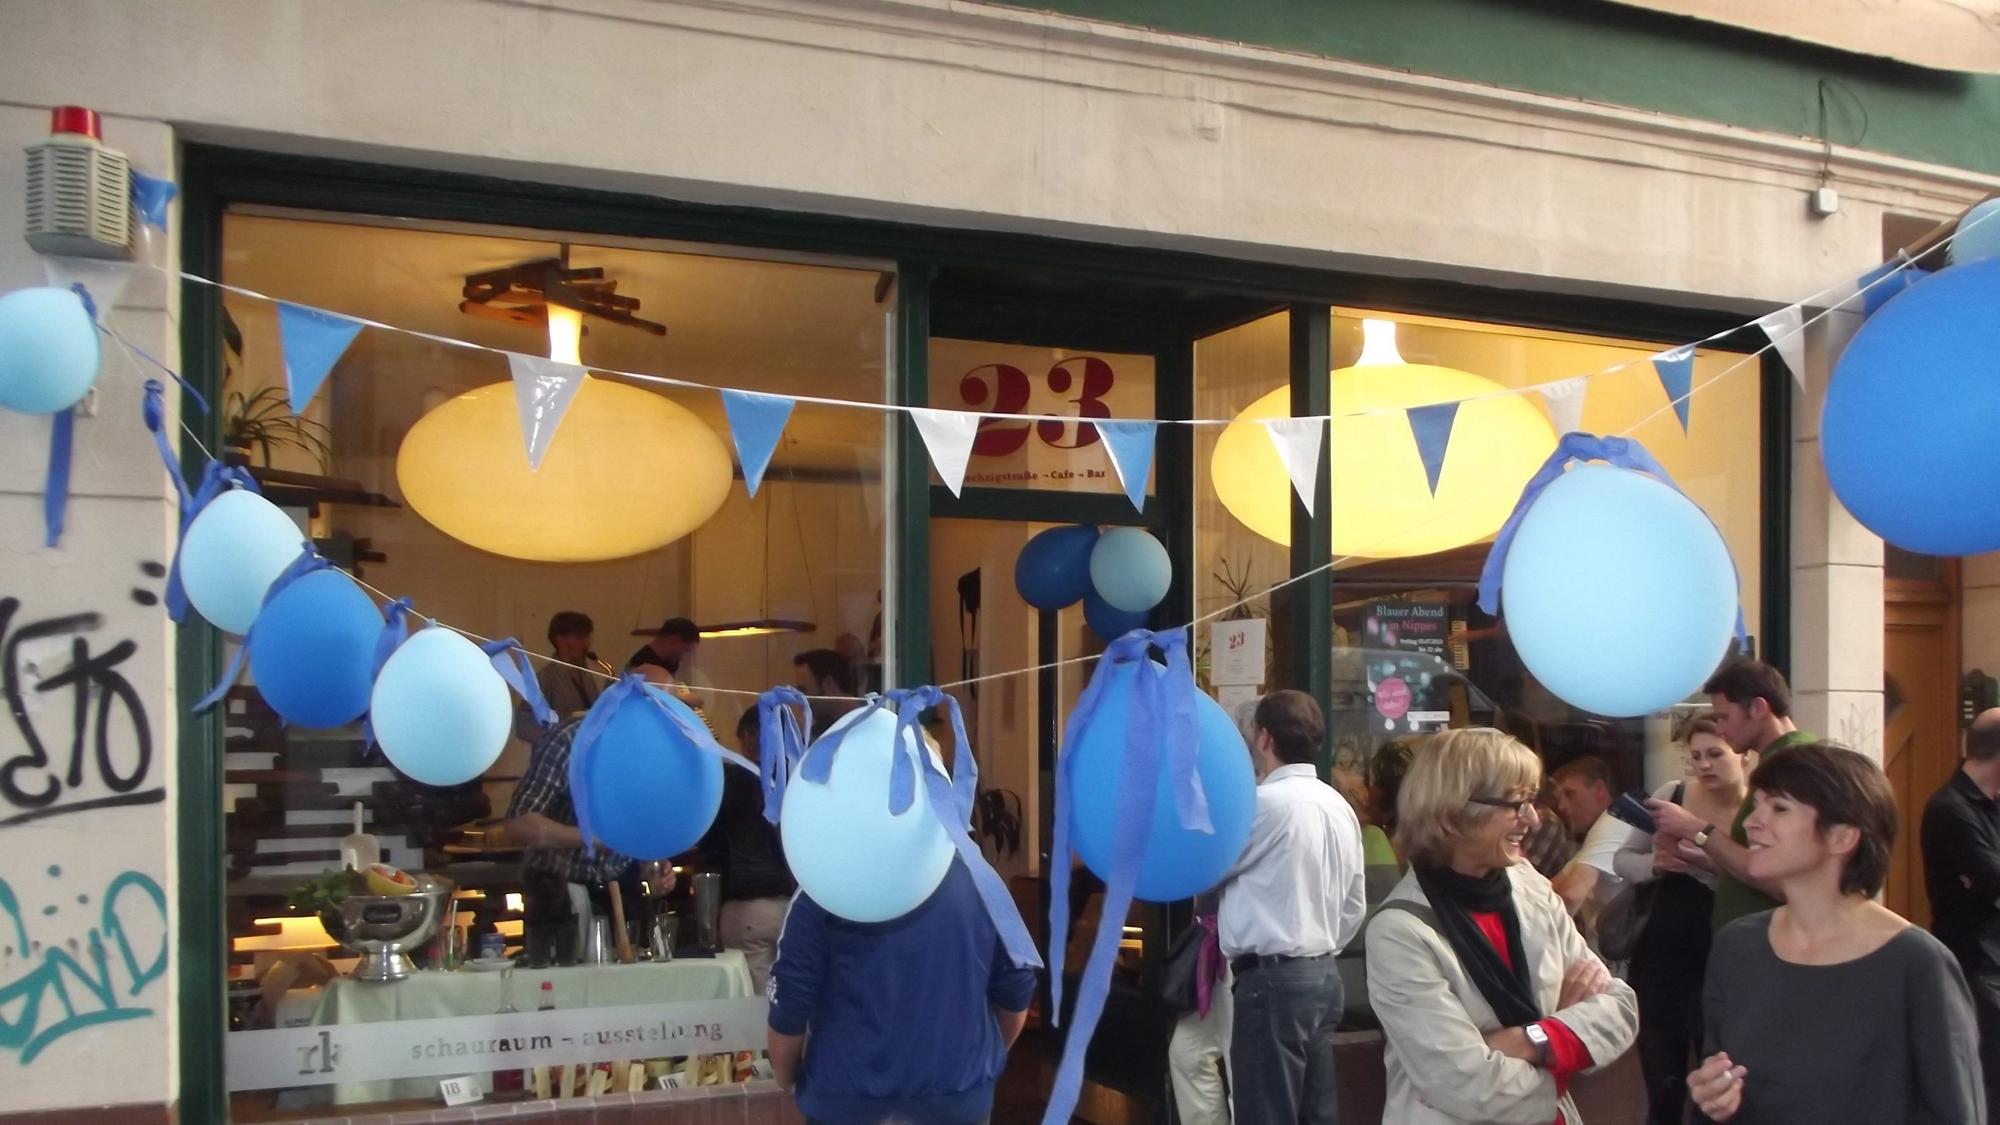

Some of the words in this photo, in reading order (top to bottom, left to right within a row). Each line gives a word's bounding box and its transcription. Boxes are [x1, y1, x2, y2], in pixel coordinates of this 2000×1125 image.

[960, 357, 1114, 457] 23
[1051, 469, 1075, 479] Cafe
[1087, 469, 1105, 479] Bar
[1376, 604, 1409, 616] Blauer
[1411, 606, 1444, 617] Abend
[297, 1031, 344, 1075] rk
[411, 1036, 552, 1059] schauraum
[582, 1021, 723, 1046] ausstellung
